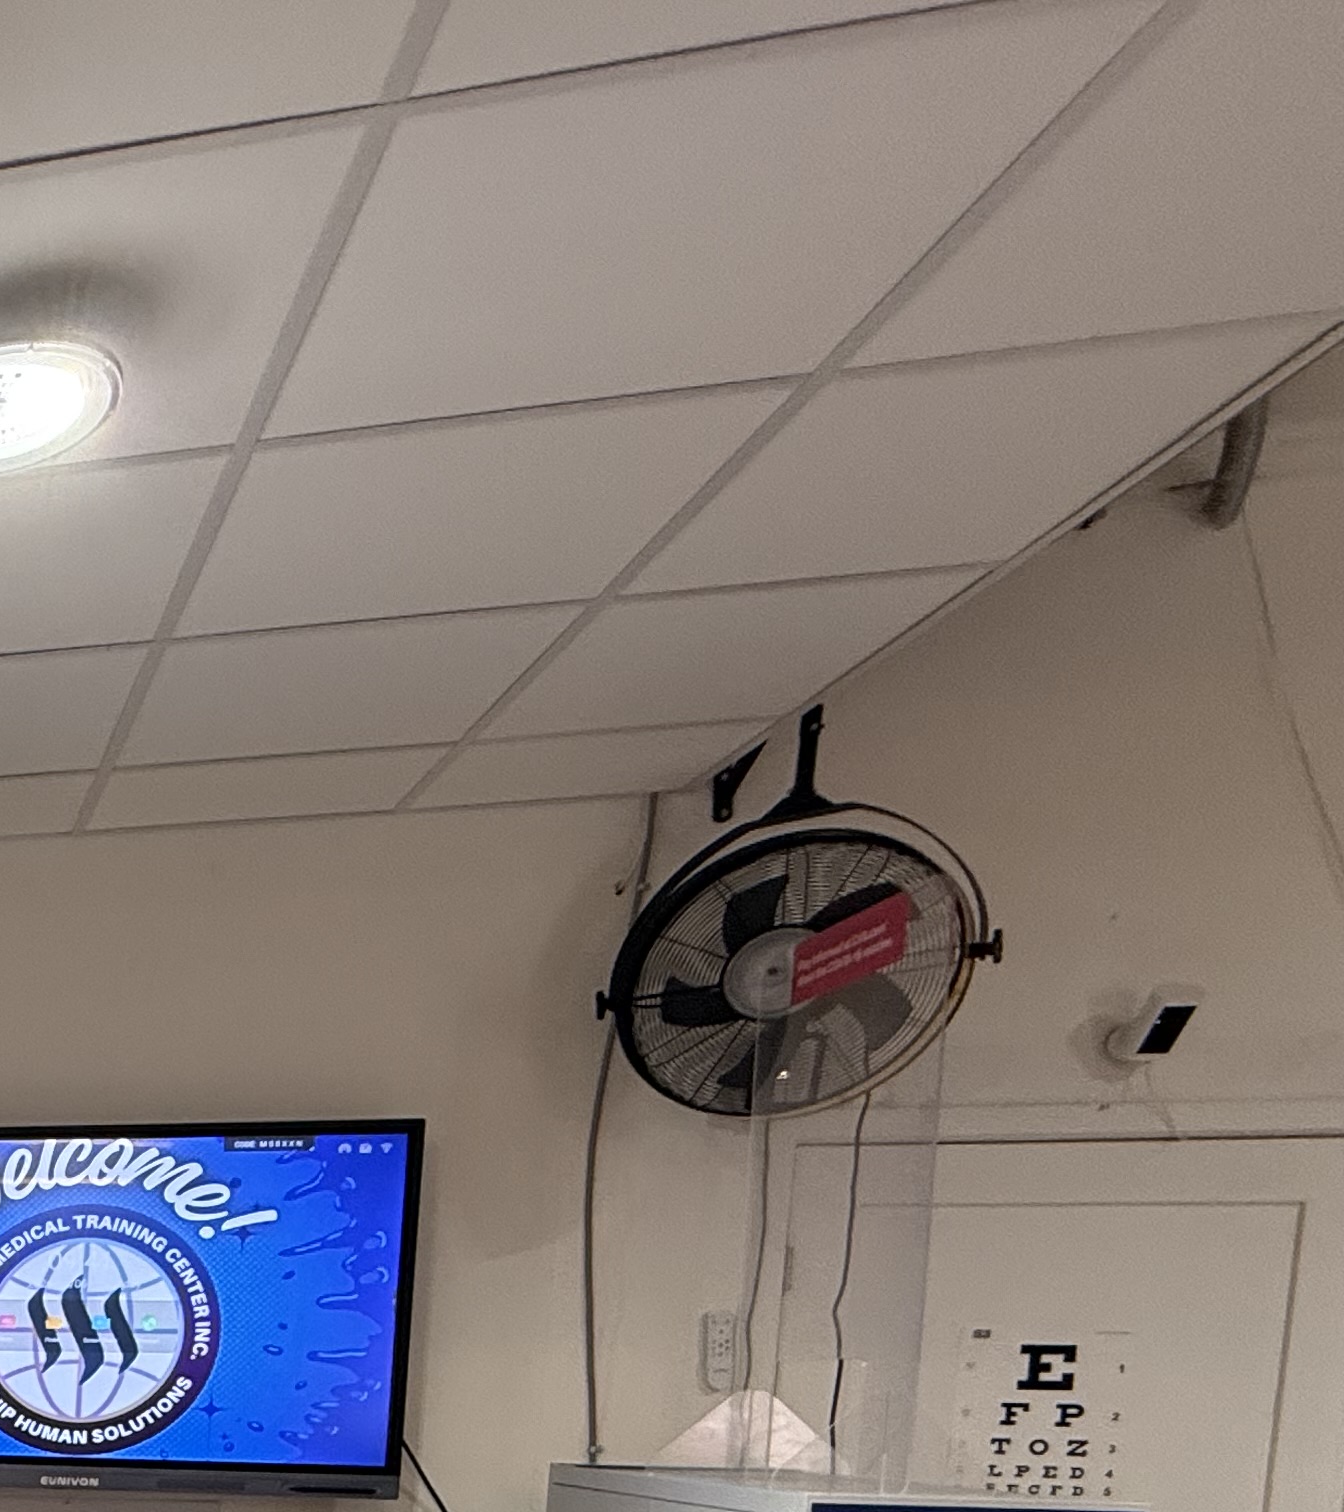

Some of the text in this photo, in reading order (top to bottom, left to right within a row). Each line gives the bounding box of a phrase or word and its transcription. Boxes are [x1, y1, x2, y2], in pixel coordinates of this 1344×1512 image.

[72, 1214, 168, 1252] TRAINING
[165, 1249, 209, 1317] CENTER
[189, 1321, 211, 1360] INC.
[1016, 1344, 1077, 1390] E
[14, 1417, 87, 1444] HUMAN
[92, 1375, 193, 1444] SOLUTIONS
[40, 1476, 99, 1487] EUNIVON
